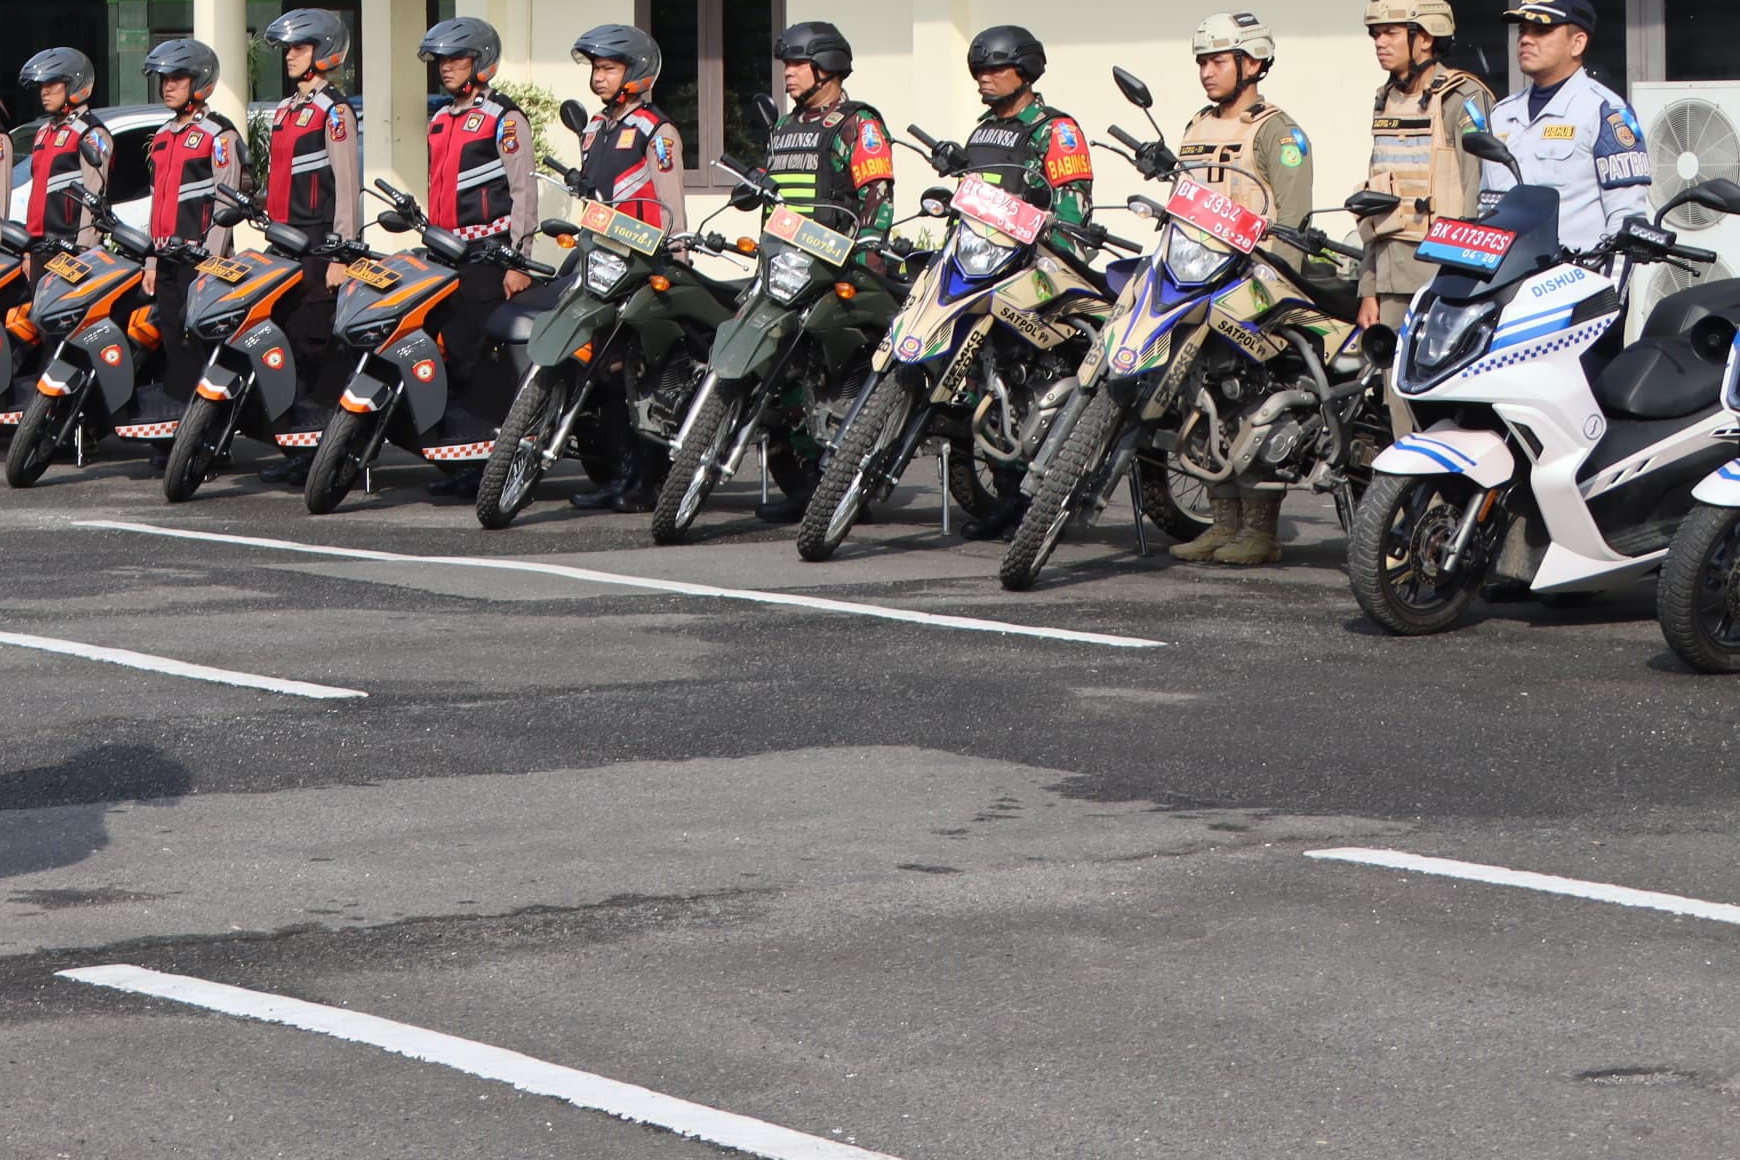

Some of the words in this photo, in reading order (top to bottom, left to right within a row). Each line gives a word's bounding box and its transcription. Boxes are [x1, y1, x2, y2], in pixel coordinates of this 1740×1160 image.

[971, 128, 1020, 147] BABINSA
[1596, 151, 1651, 183] PATRO
[963, 178, 983, 196] BK
[1028, 213, 1041, 229] A
[1178, 181, 1198, 201] BK
[1249, 221, 1262, 236] A
[1431, 222, 1452, 239] BK
[1450, 227, 1483, 246] 4173
[1482, 232, 1510, 251] FCS
[1531, 268, 1586, 298] DISHUB
[1000, 307, 1037, 338] SATPOL
[1218, 320, 1257, 352] SATPOL
[942, 330, 980, 389] PEMKO
